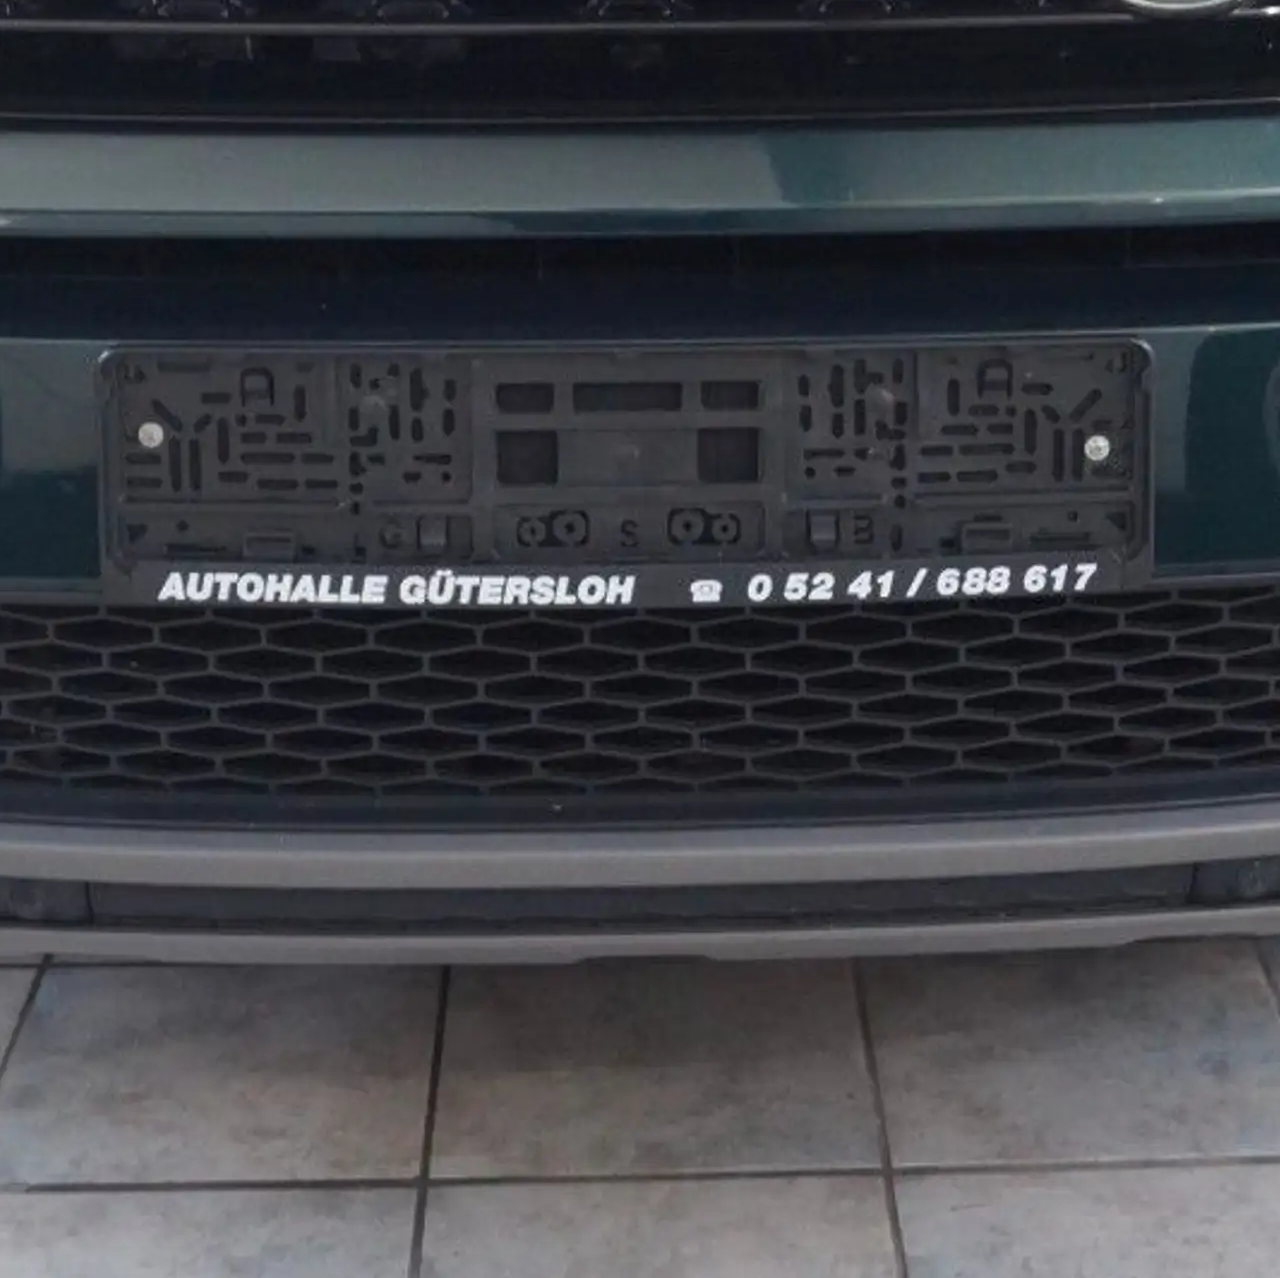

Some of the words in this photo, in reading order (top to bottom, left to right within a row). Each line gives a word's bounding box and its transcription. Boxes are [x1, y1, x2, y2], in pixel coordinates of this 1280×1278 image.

[157, 571, 389, 605] AUTOHALLE
[399, 568, 637, 606] GÜTERSLOH
[747, 573, 773, 603] 0
[783, 571, 836, 602] 52
[846, 569, 895, 600] 41
[935, 565, 1012, 597] 688
[1022, 562, 1098, 594] 617
